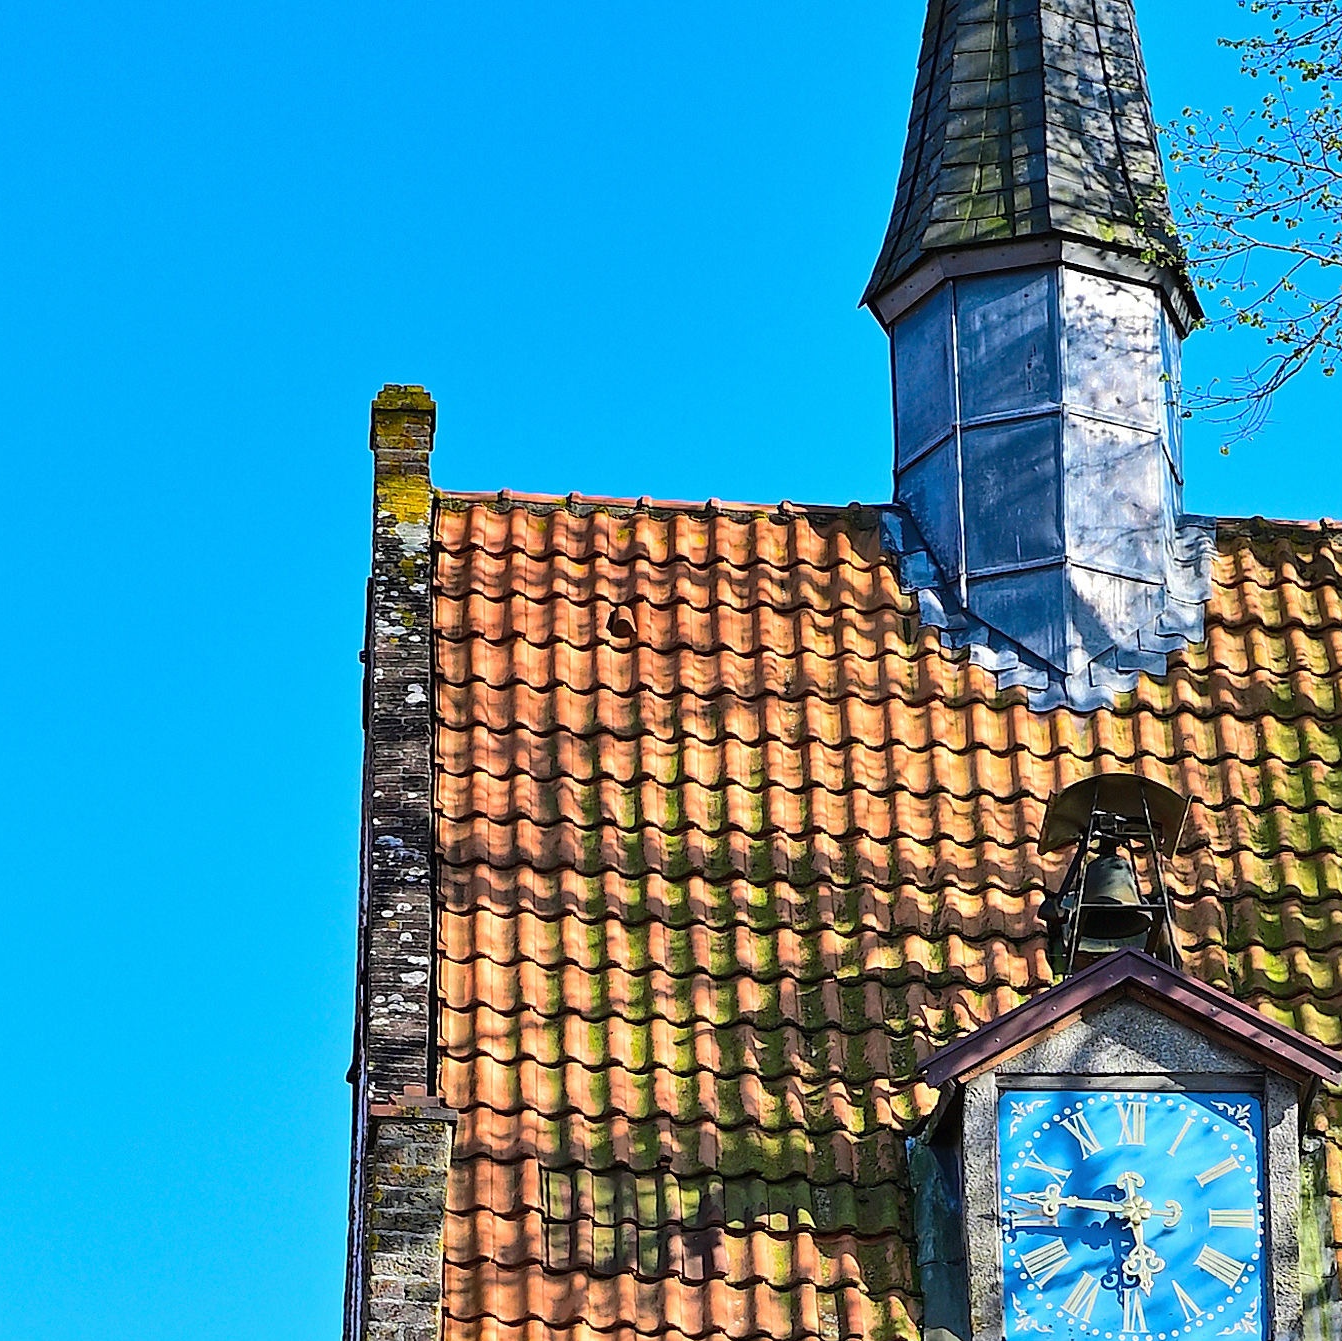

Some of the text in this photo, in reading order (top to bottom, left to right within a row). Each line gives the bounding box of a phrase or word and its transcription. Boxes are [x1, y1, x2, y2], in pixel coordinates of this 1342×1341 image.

[1060, 1111, 1104, 1160] XI
[1114, 1102, 1147, 1145] XII
[1167, 1116, 1196, 1156] I
[1023, 1149, 1073, 1187] X
[1194, 1154, 1241, 1187] II
[1208, 1208, 1255, 1230] III
[1020, 1237, 1072, 1290] VIII
[1061, 1271, 1102, 1323] VII
[1171, 1279, 1206, 1323] V
